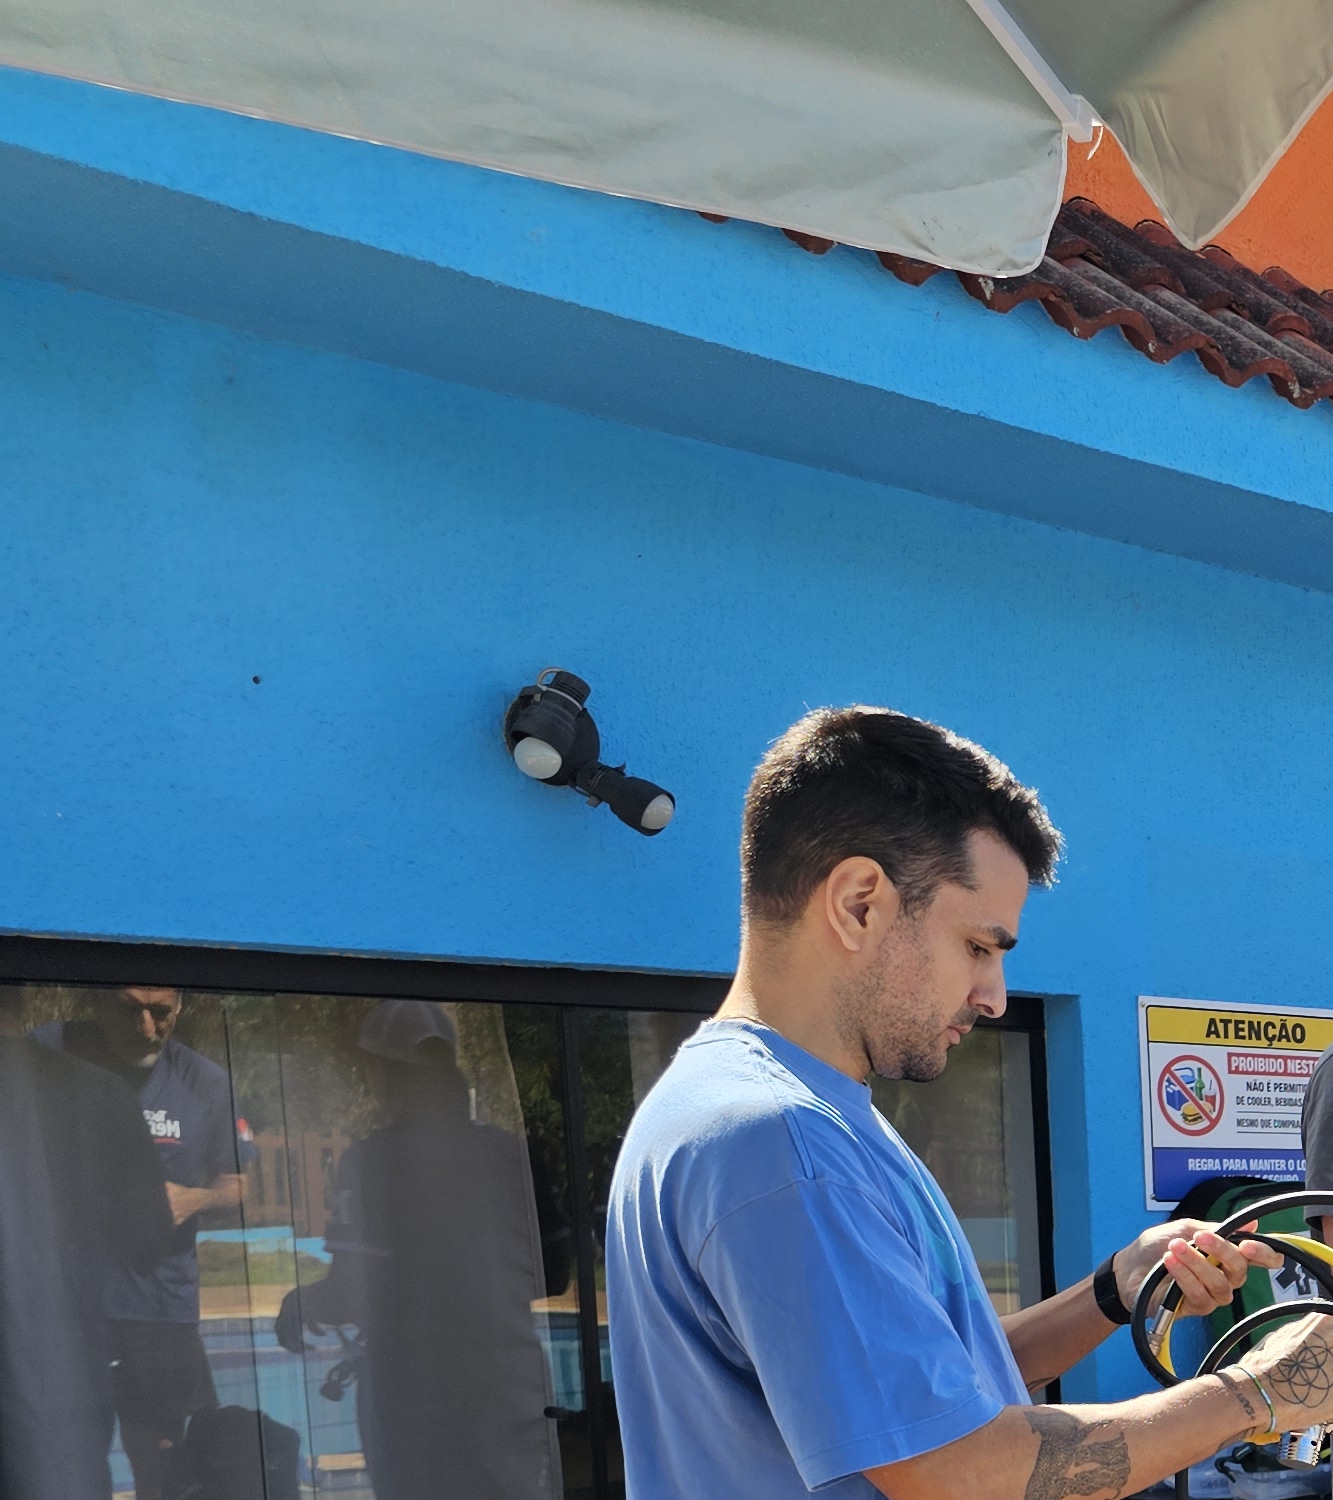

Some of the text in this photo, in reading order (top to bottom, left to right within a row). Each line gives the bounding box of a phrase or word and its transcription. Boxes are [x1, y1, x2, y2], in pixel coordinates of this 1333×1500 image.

[1205, 1018, 1306, 1046] ATENÇÃO
[1231, 1056, 1284, 1073] PROIBIDO
[1246, 1079, 1264, 1093] NÃO
[1267, 1079, 1272, 1092] É
[1236, 1096, 1245, 1106] DE
[1247, 1096, 1274, 1107] COOLER,
[1236, 1118, 1302, 1129] MESMO QUE COMPRA
[1188, 1158, 1222, 1171] REGRA
[1222, 1158, 1248, 1171] PARA
[1249, 1159, 1286, 1171] MANTER
[1287, 1159, 1295, 1171] O
